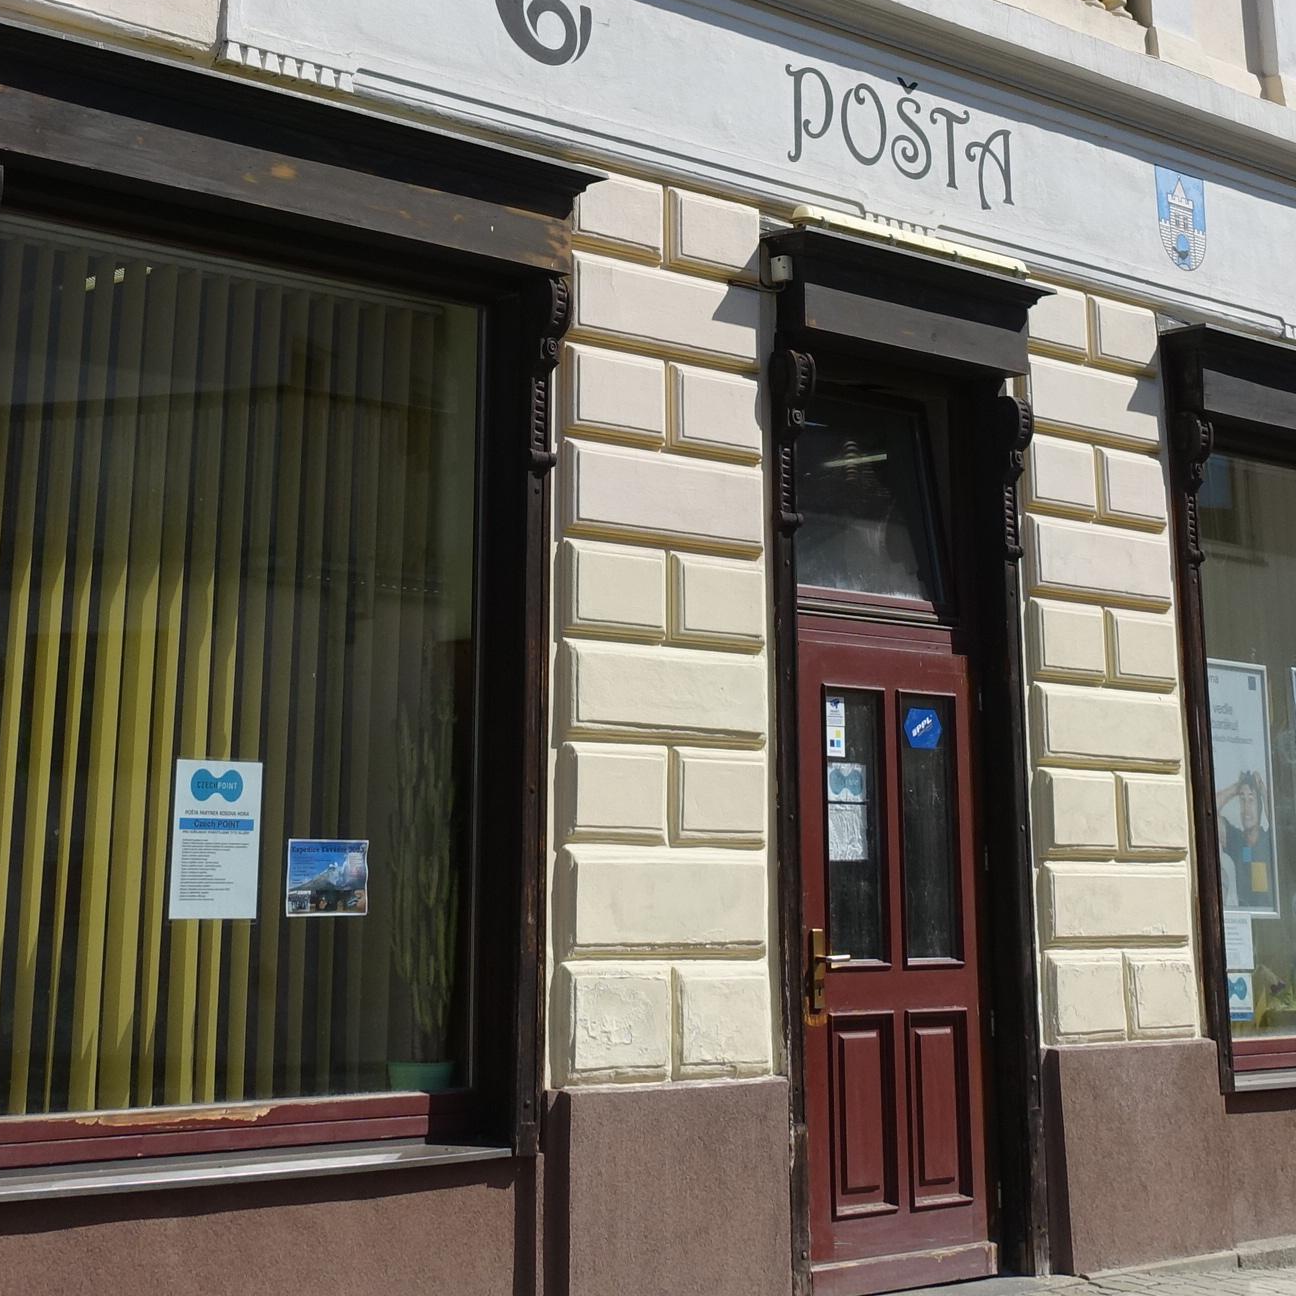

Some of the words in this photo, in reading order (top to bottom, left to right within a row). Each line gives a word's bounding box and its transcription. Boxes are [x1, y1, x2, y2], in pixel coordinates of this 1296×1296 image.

[785, 64, 1015, 210] POŠTA
[916, 716, 933, 734] PPL
[217, 820, 240, 830] POINT
